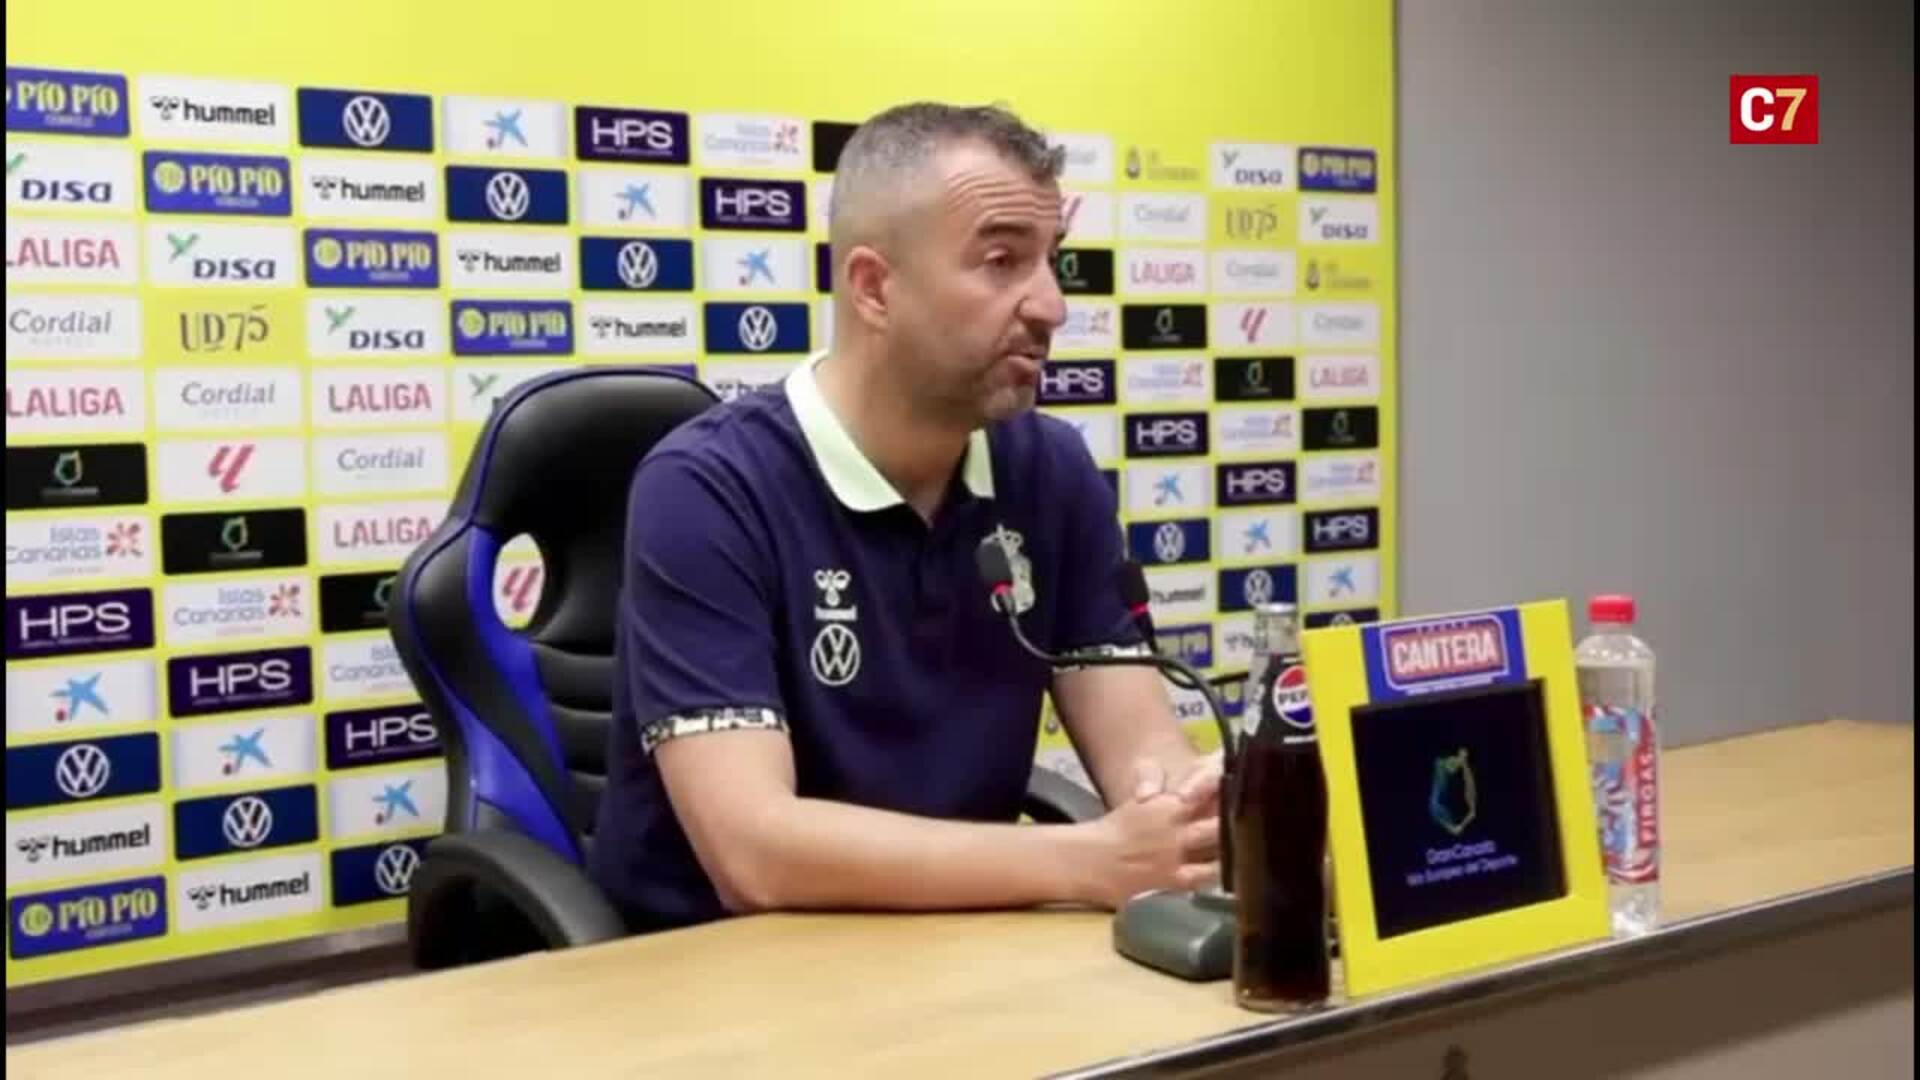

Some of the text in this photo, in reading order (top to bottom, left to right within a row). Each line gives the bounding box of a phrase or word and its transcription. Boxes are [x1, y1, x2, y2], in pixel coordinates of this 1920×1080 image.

[183, 99, 275, 125] hummel
[593, 114, 672, 149] HPS
[341, 179, 425, 202] hummel
[716, 189, 790, 217] HPS
[484, 252, 561, 273] hummel
[1131, 261, 1195, 285] LALIGA
[9, 309, 111, 334] Cordial
[614, 319, 686, 338] hummel
[181, 382, 275, 405] Cordial
[1040, 367, 1105, 393] HPS
[7, 388, 124, 418] LALIGA
[328, 384, 431, 413] LALIGA
[1137, 420, 1197, 446] HPS
[337, 448, 424, 471] Cordial
[1227, 469, 1285, 495] HPS
[334, 517, 433, 547] LALIGA
[1314, 515, 1368, 540] HPS
[21, 602, 130, 640] HPS
[1393, 629, 1498, 674] CANTERA
[191, 659, 290, 697] HPS
[346, 714, 437, 749] HPS
[1640, 752, 1657, 846] FIRGAS
[52, 824, 150, 858] hummel
[220, 872, 309, 905] hummel
